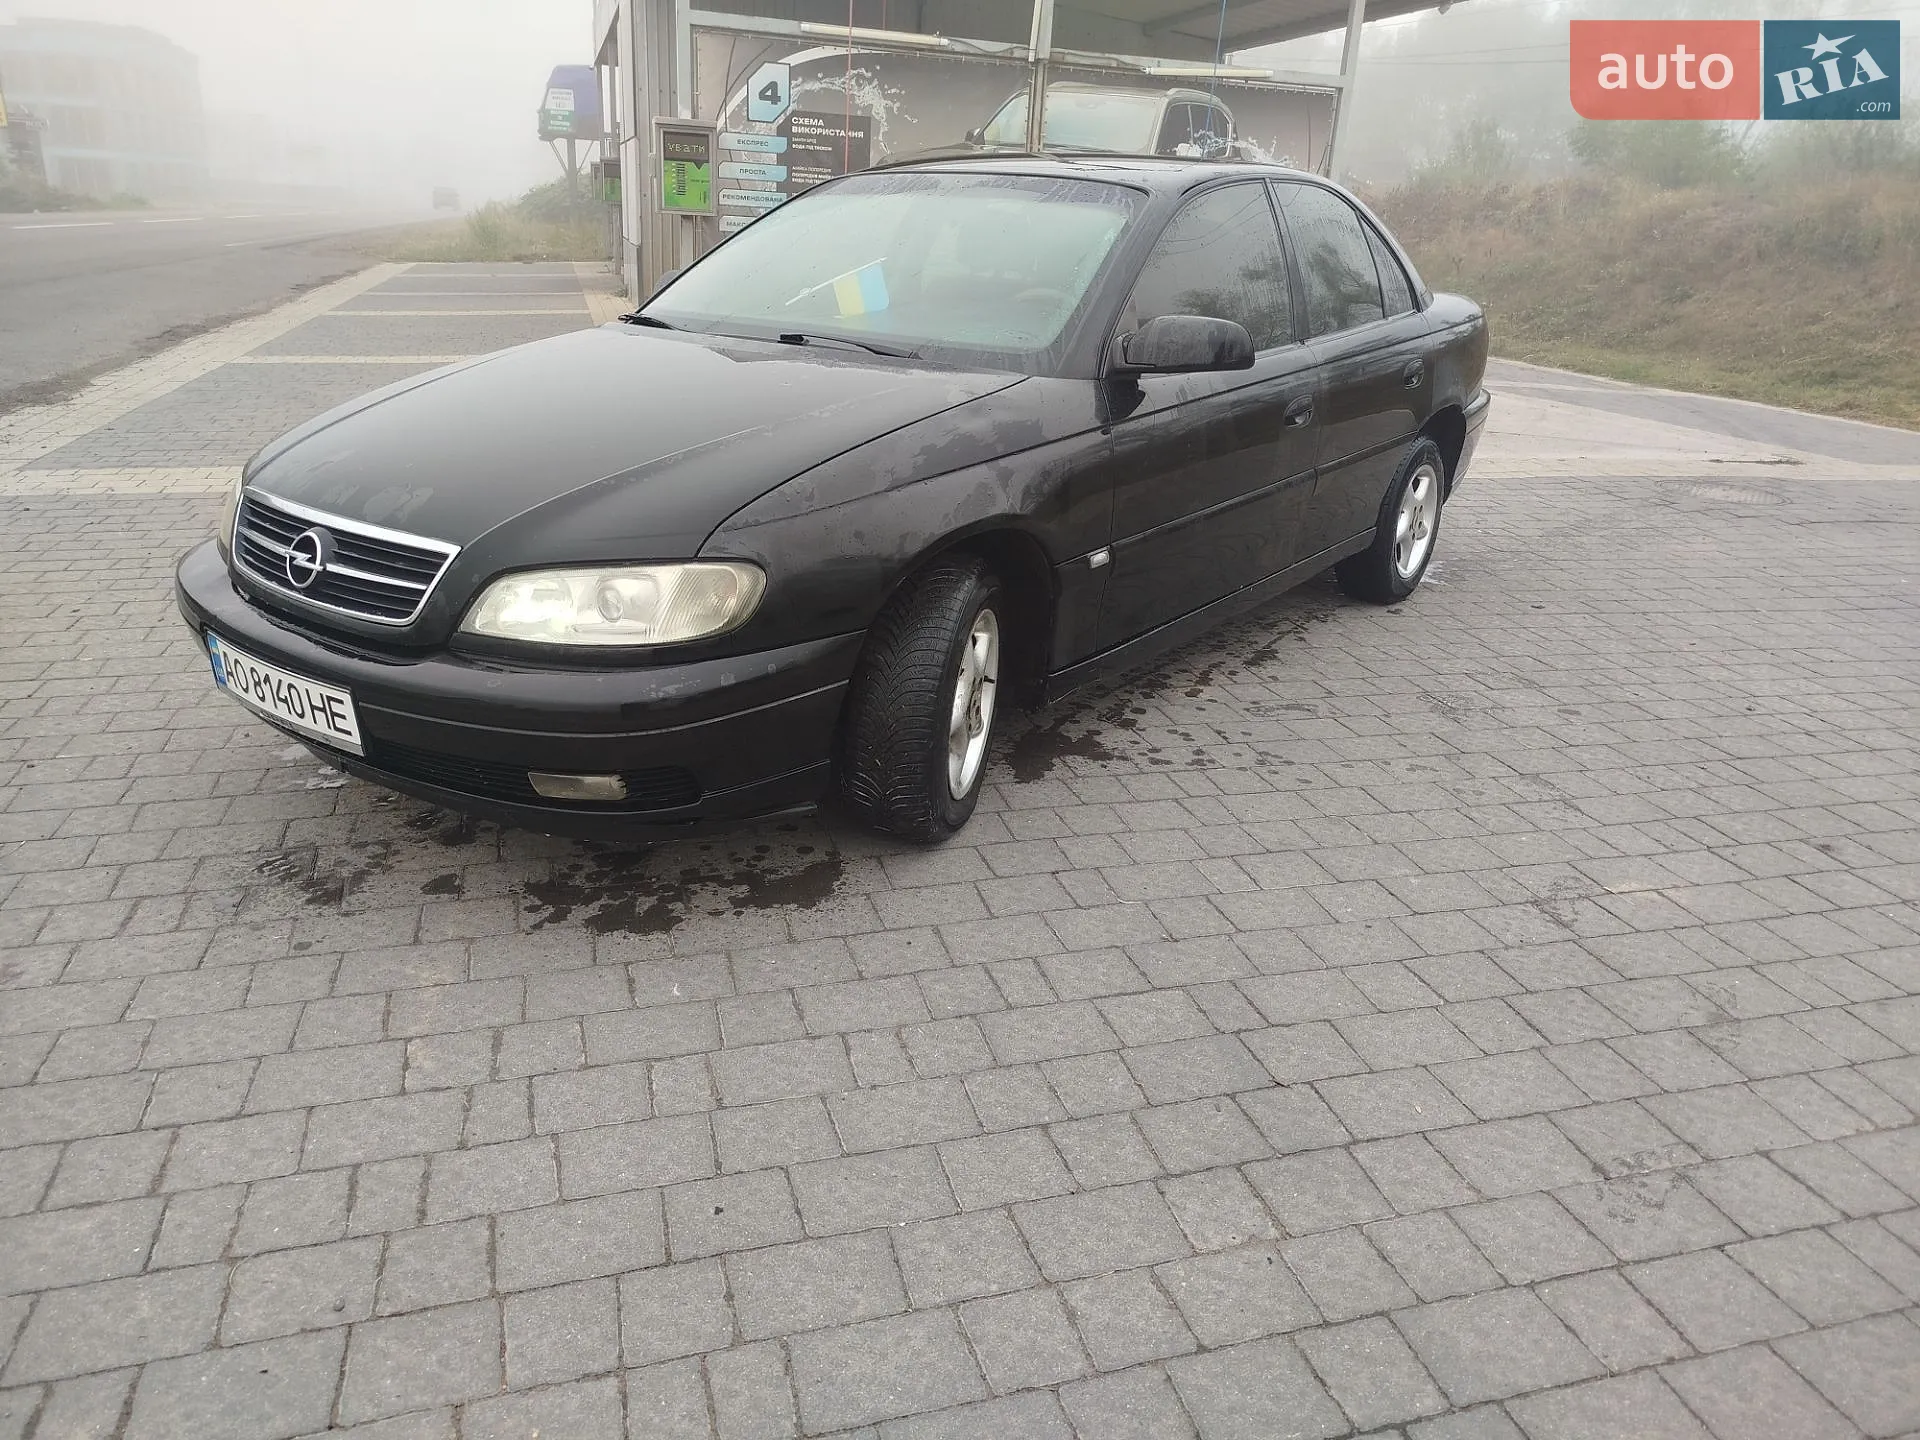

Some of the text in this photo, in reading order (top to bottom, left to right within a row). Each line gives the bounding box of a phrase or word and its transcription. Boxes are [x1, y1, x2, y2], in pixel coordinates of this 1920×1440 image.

[758, 80, 782, 105] 4
[791, 116, 825, 127] СХЕМА
[791, 125, 864, 139] ВИКОРИСТАННЯ
[736, 138, 769, 147] ЕКСПРЕС
[739, 168, 767, 176] ПРОСТА
[223, 651, 250, 695] AO
[250, 666, 305, 720] 8140
[305, 688, 353, 737] HE
